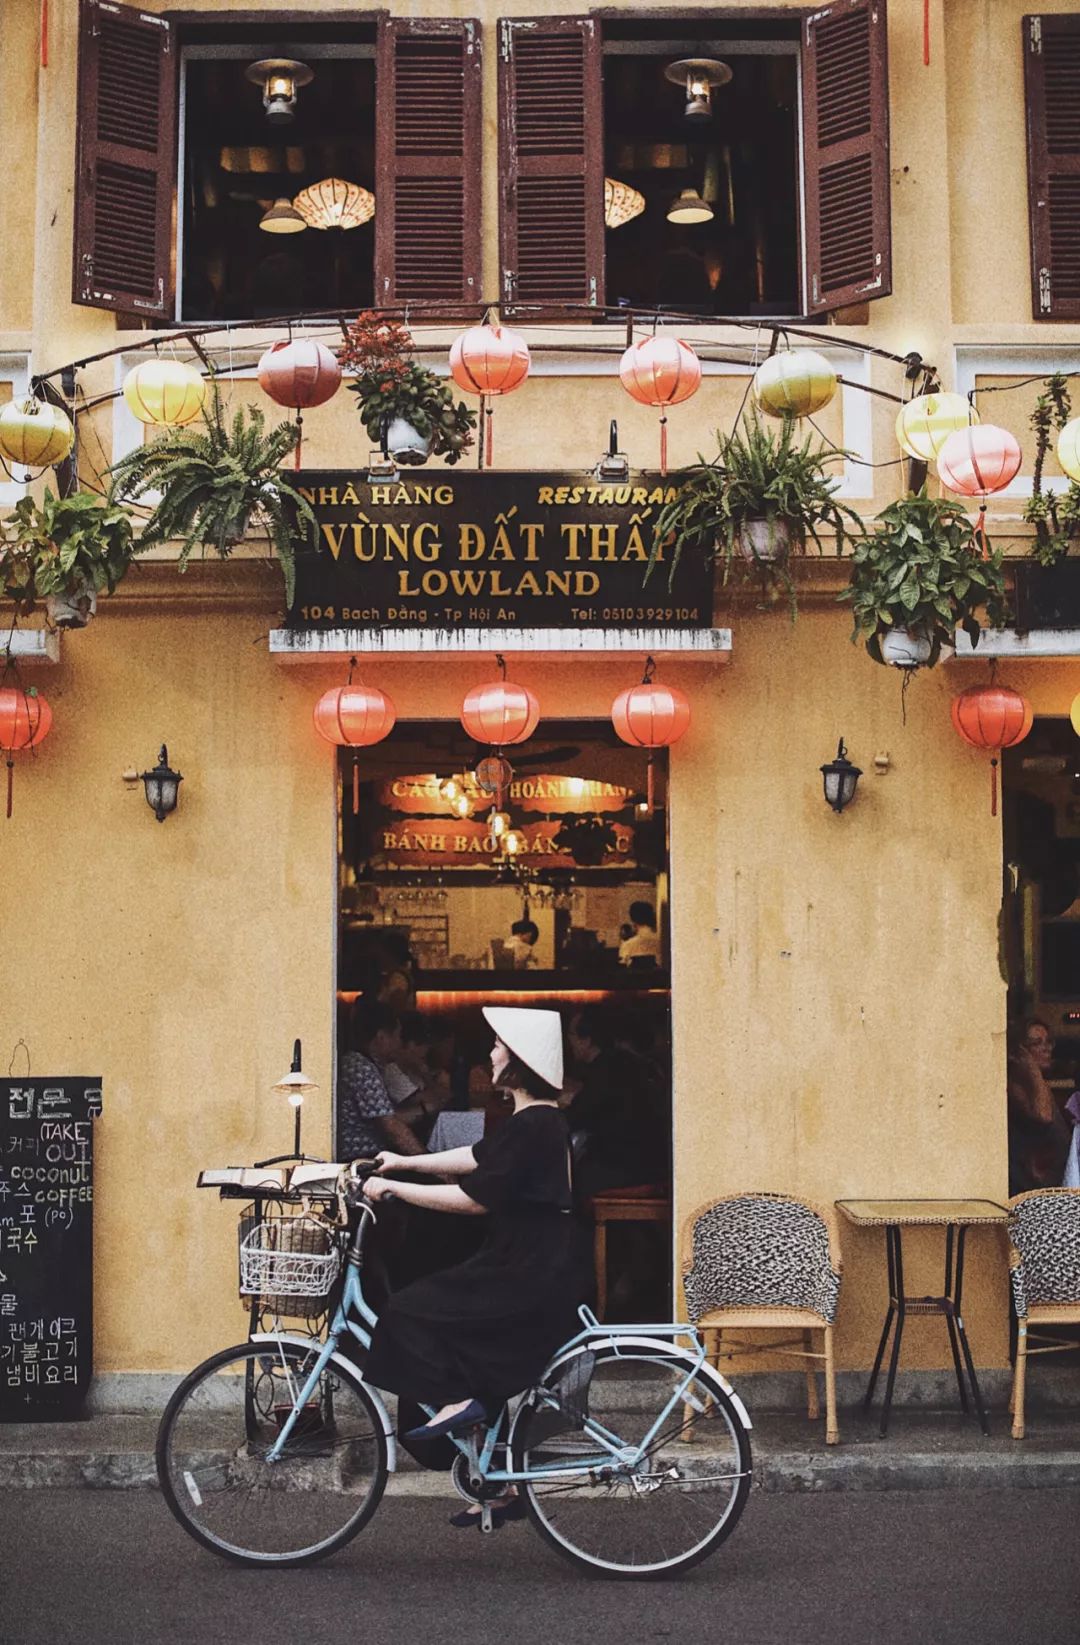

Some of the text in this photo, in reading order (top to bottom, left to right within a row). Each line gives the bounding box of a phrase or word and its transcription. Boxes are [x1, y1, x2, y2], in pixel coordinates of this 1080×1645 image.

[299, 482, 454, 505] NHÀ HÀNG
[538, 486, 681, 505] RESTAURAN
[321, 505, 677, 562] VÙNG ĐẤT THẤP
[398, 569, 600, 596] LOWLAND
[301, 606, 335, 620] 104
[444, 608, 463, 622] Tp
[496, 608, 516, 621] An
[571, 608, 597, 621] Tel:
[383, 827, 447, 850] BÁNH
